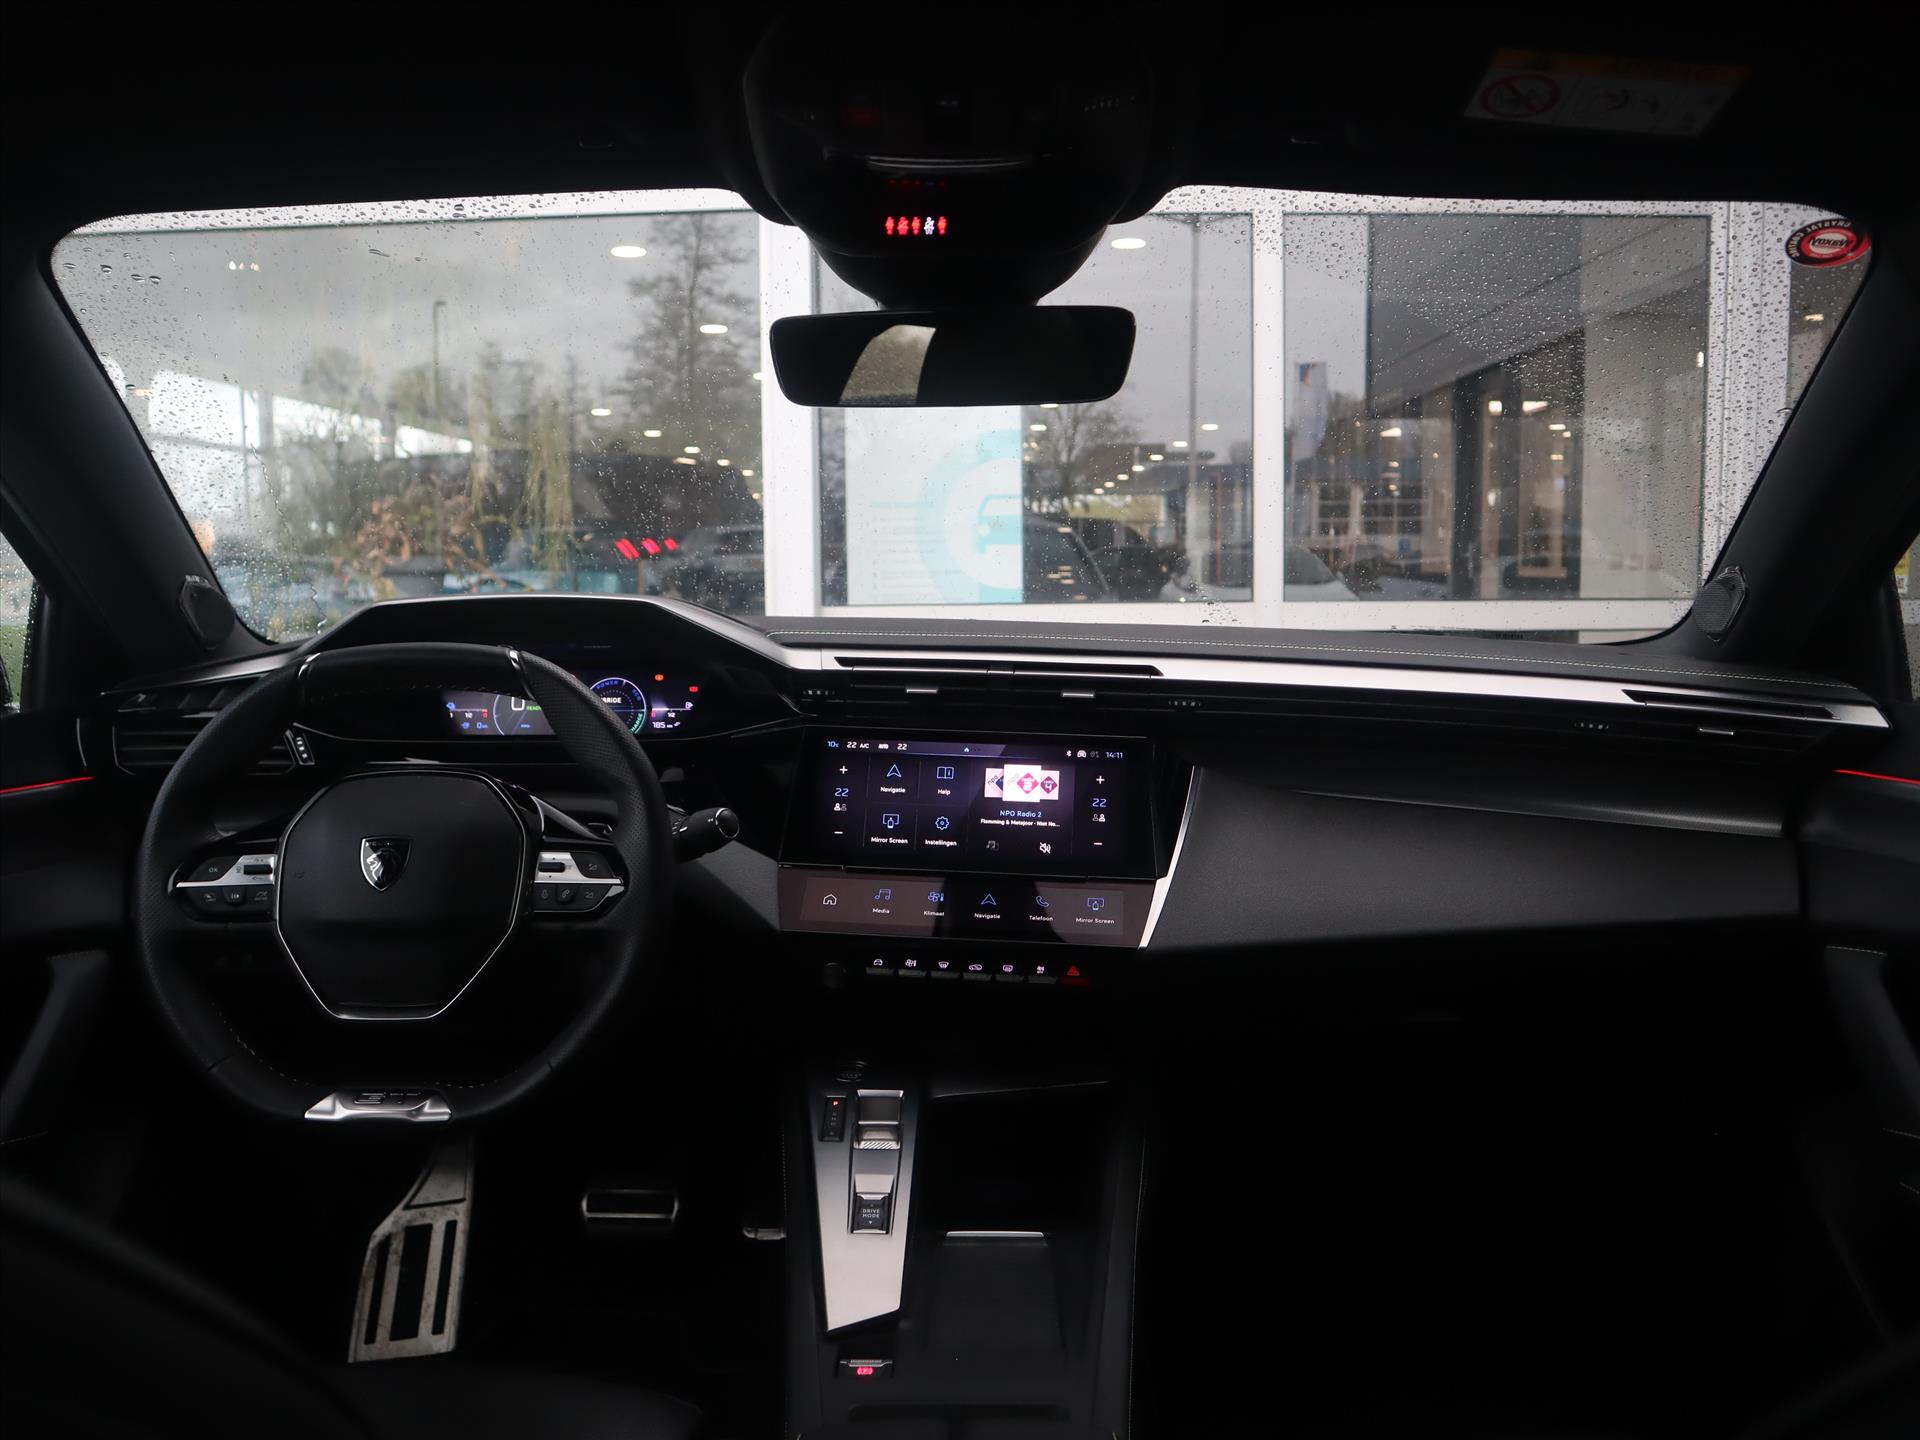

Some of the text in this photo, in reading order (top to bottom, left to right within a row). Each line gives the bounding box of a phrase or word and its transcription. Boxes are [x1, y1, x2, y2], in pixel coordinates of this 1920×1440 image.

[652, 721, 666, 729] 185
[1105, 751, 1124, 759] 14:11
[834, 787, 849, 797] 22
[880, 786, 906, 794] Navigatie
[937, 788, 951, 796] Help
[1092, 797, 1107, 808] 22
[1017, 810, 1036, 818] Radio
[870, 836, 888, 844] Mirror
[925, 839, 957, 847] Instellingen
[974, 912, 1001, 920] Navigatie
[1029, 914, 1054, 922] Telefoon
[1075, 916, 1093, 924] Mirror
